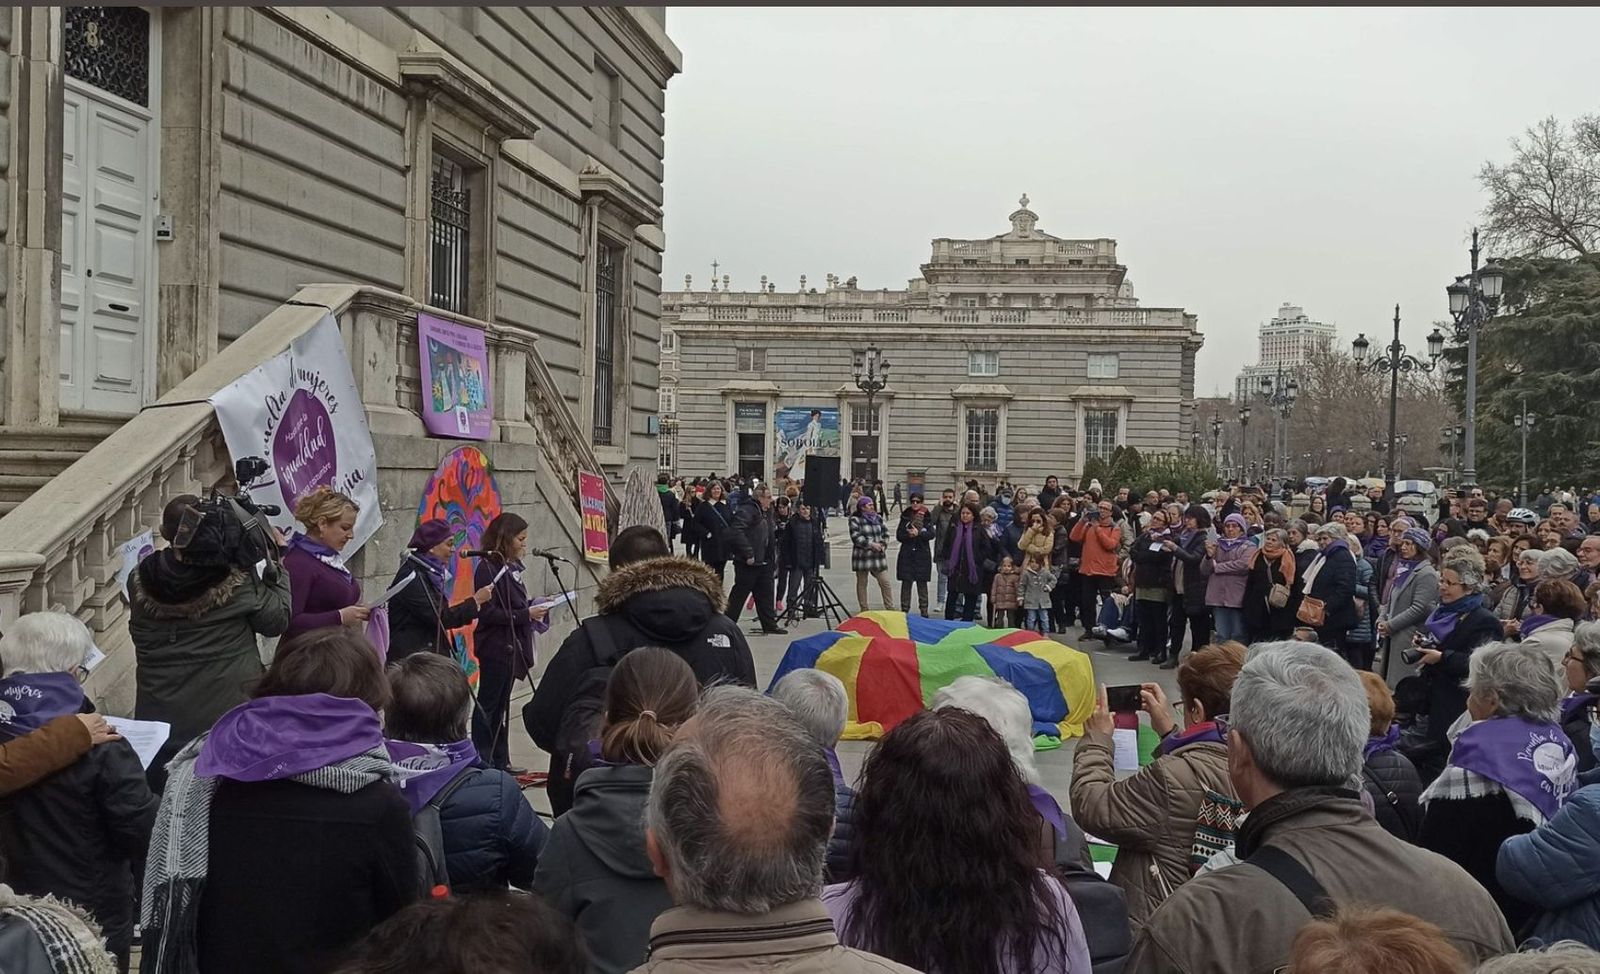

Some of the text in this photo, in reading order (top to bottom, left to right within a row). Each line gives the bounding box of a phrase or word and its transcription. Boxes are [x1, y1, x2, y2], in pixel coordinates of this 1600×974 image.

[87, 21, 98, 47] 8
[280, 416, 327, 494] igualdad
[4, 684, 42, 701] mujeres
